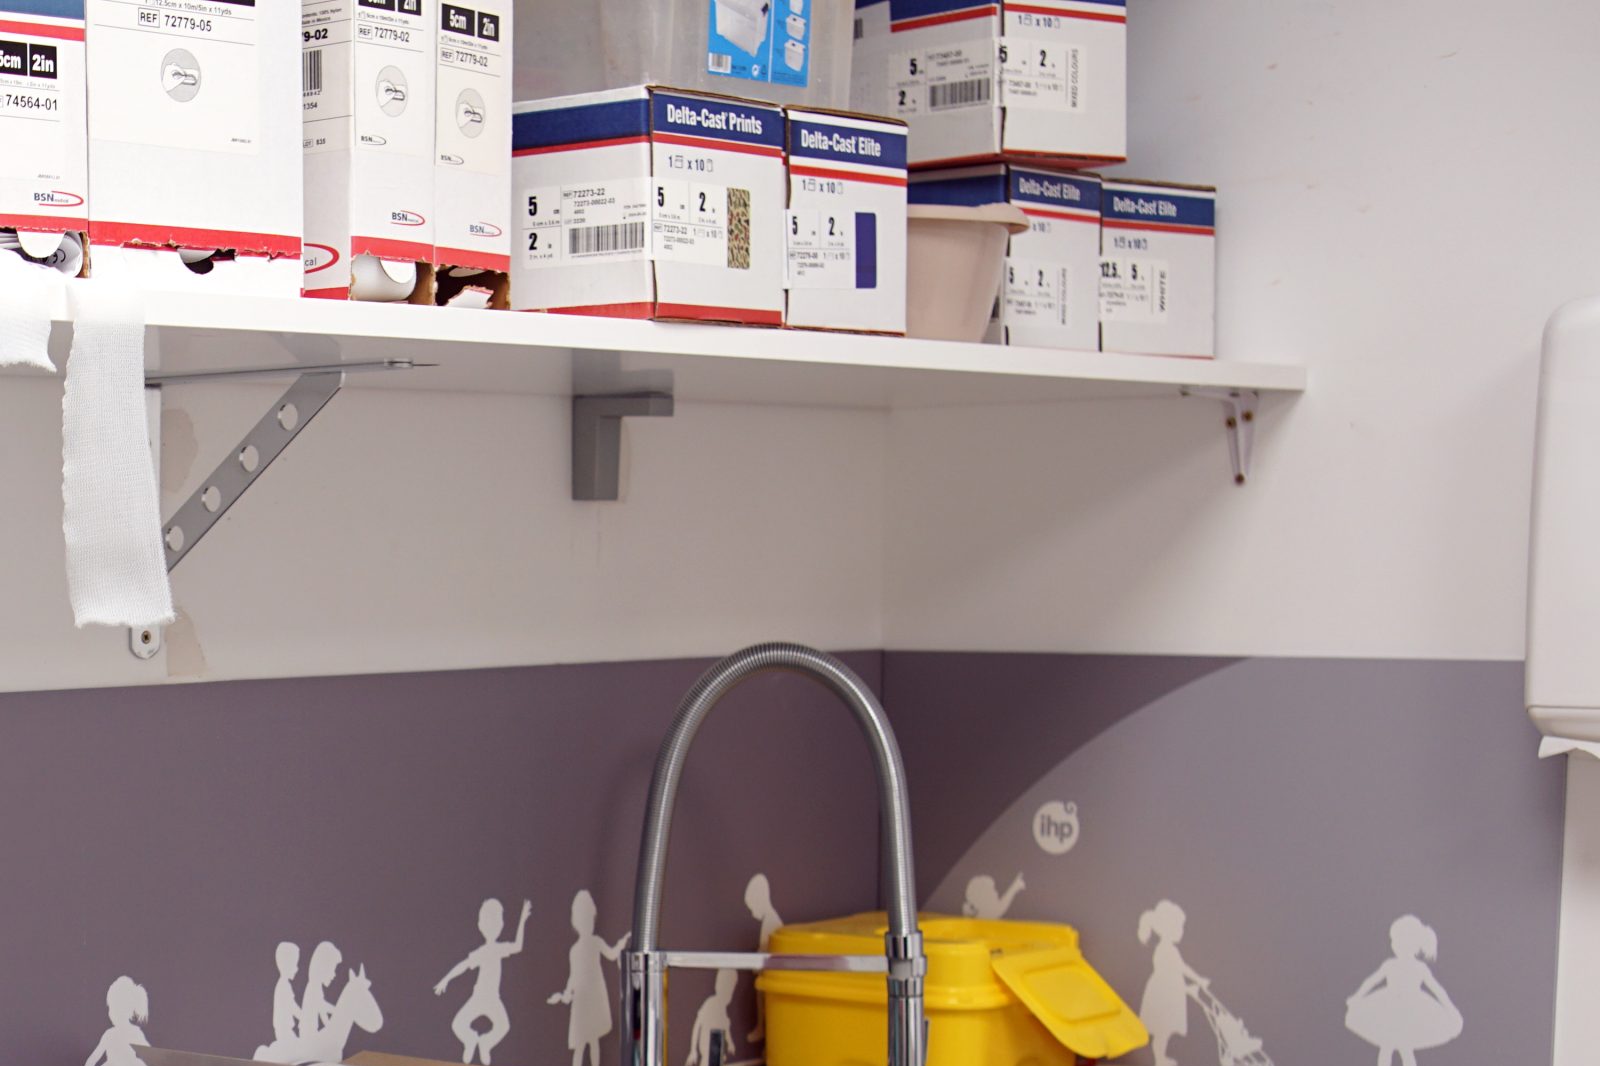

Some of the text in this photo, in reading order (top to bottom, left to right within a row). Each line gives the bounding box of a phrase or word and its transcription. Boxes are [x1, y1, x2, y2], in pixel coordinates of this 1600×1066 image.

[140, 12, 212, 32] REF 72779-05
[450, 10, 496, 37] 5cm 2in
[302, 28, 328, 42] 9-02
[359, 26, 410, 43] REF 72779-02
[32, 53, 54, 74] 2in
[455, 50, 489, 68] 72779-02
[999, 46, 1047, 67] 5 2
[909, 58, 917, 76] 5
[5, 94, 58, 112] 74564-01
[898, 90, 906, 106] 2
[666, 103, 762, 135] Delta-Cast Prints
[801, 128, 881, 158] Delta-Cast Elite
[695, 158, 705, 172] 10
[826, 181, 835, 194] 10
[1063, 184, 1081, 201] Elite
[33, 192, 55, 203] BSN
[528, 196, 538, 216] 5
[657, 186, 664, 208] 5
[699, 192, 706, 213] 2
[391, 211, 408, 222] BSN
[1158, 200, 1177, 218] Elite
[469, 224, 485, 234] BSN
[791, 215, 835, 236] 5 2
[528, 232, 538, 251] 2
[1040, 814, 1073, 844] ihp
